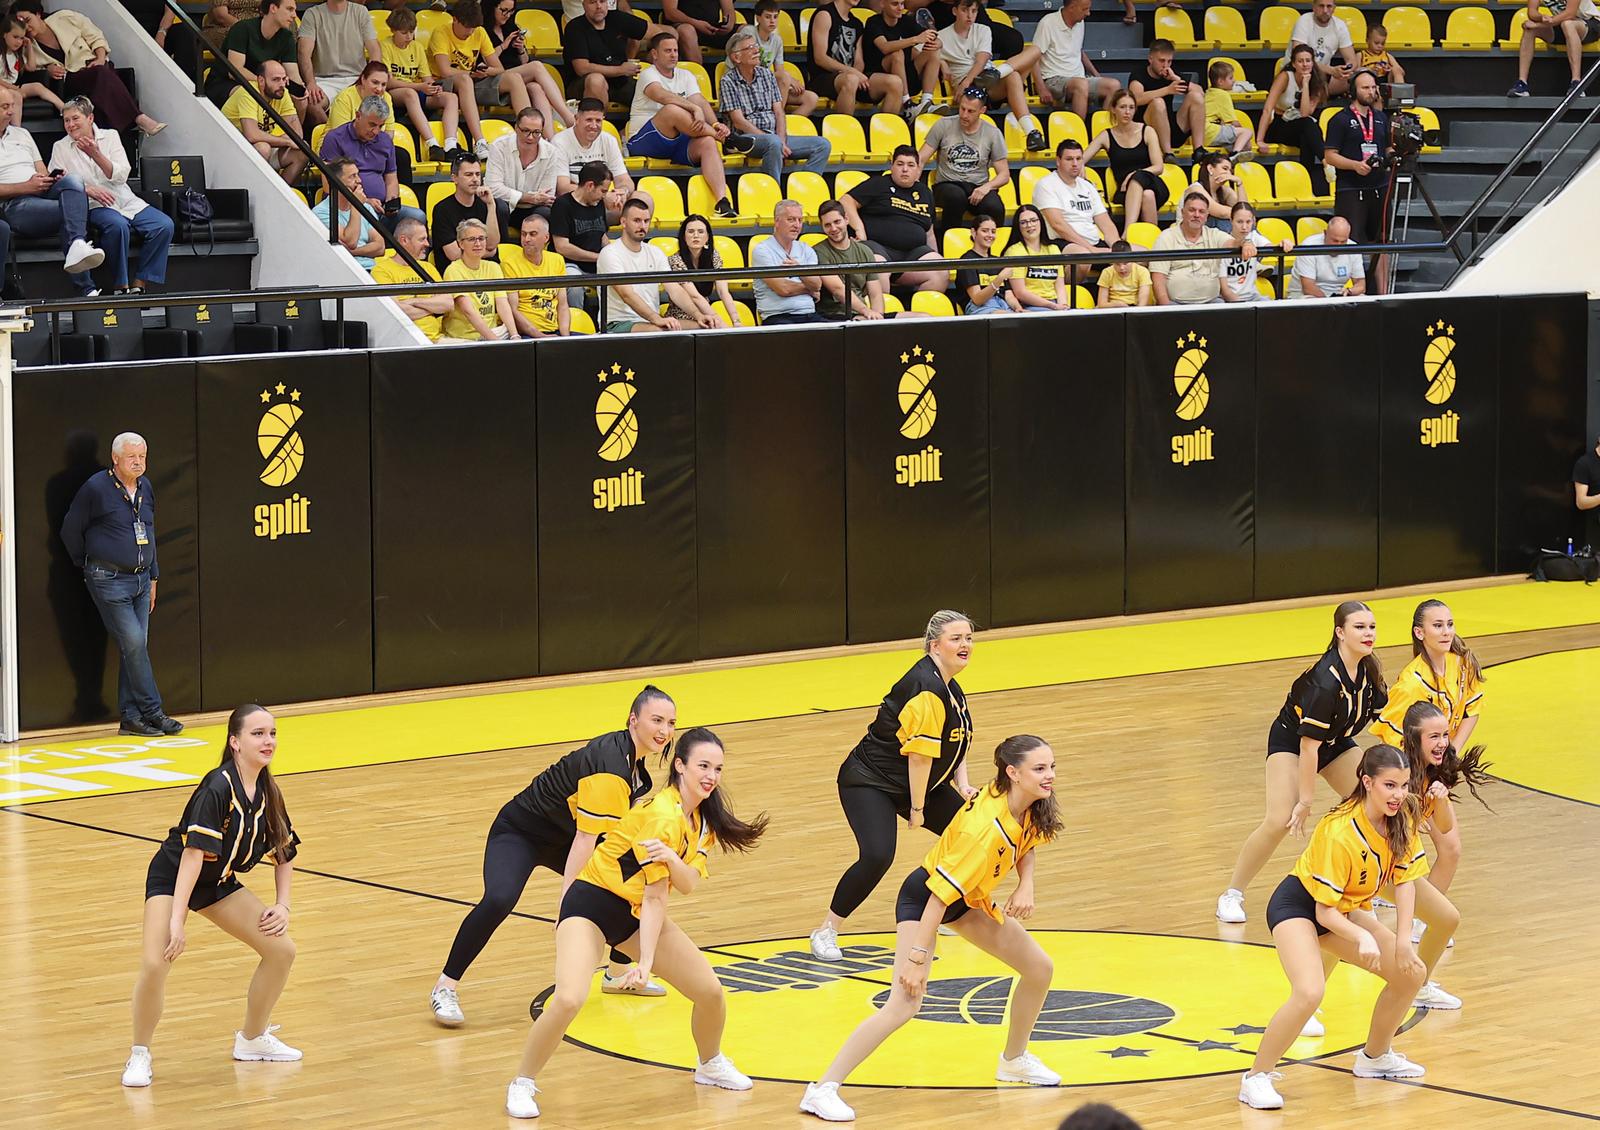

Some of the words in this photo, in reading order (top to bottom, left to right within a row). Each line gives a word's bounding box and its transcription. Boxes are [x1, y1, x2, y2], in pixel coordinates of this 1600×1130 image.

[1043, 1, 1052, 9] 10
[1101, 50, 1107, 58] 9
[1171, 426, 1215, 466] split
[1420, 409, 1461, 448] split
[895, 445, 943, 487] split
[593, 467, 646, 512] split
[254, 493, 312, 540] split
